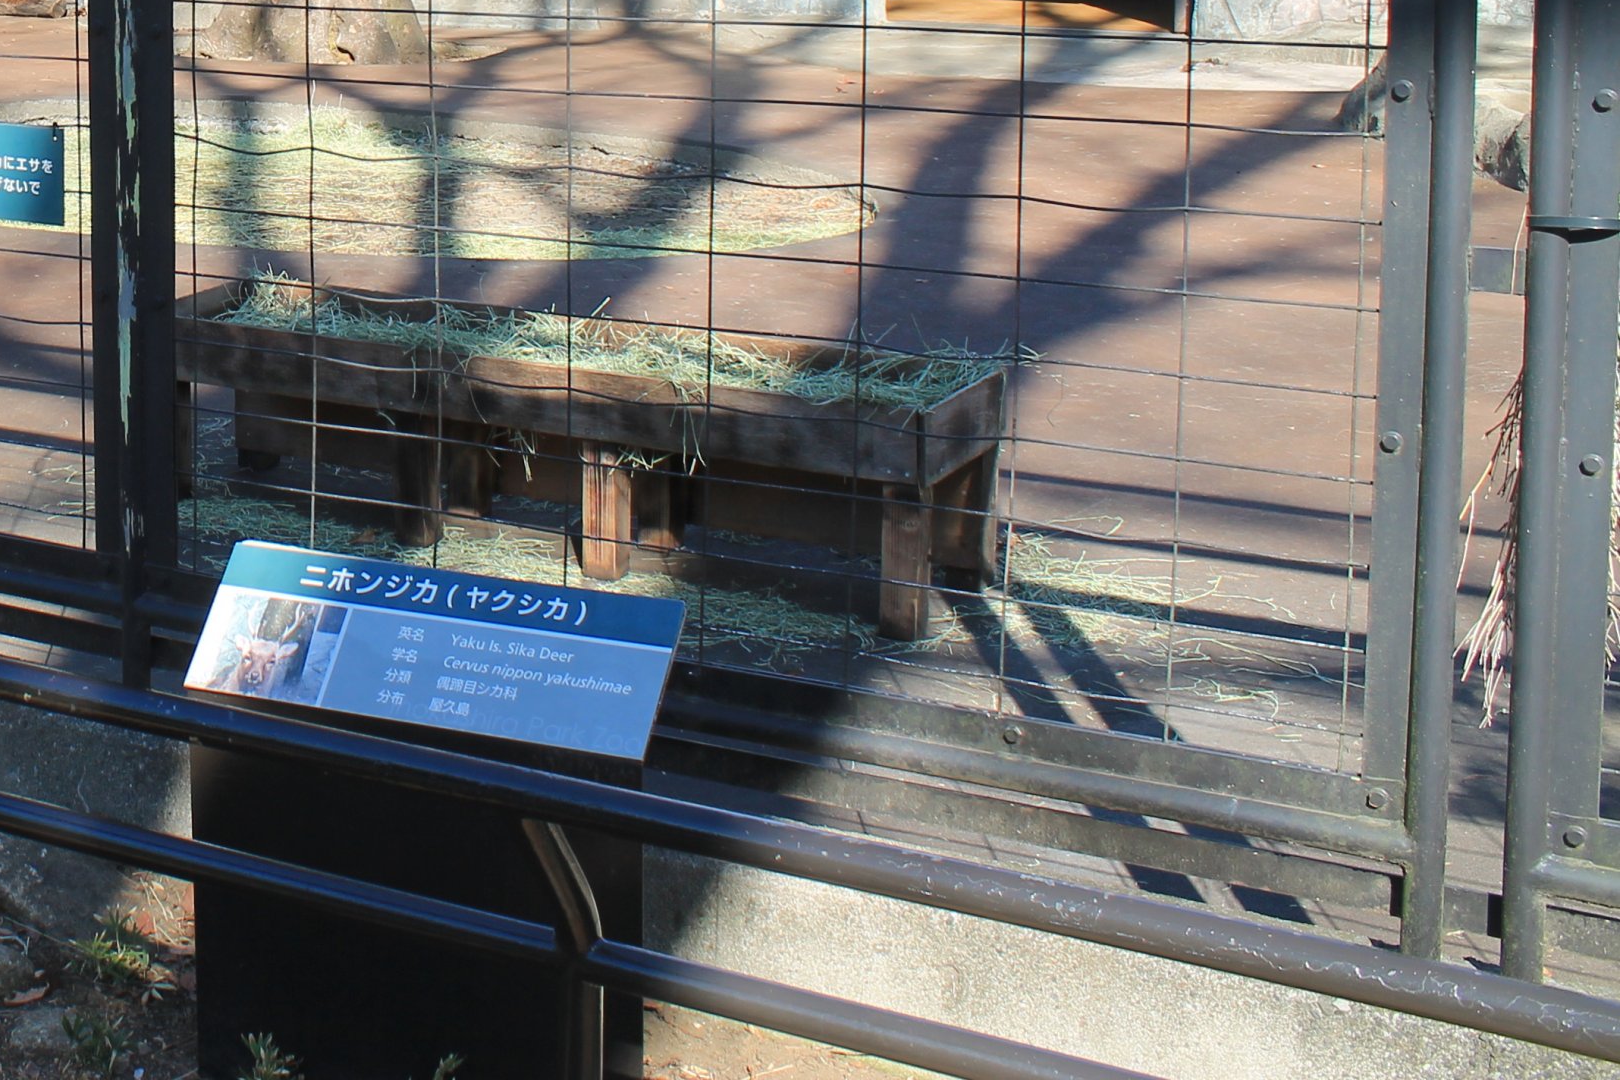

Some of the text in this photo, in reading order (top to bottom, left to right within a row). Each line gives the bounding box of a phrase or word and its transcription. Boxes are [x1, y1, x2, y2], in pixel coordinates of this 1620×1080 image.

[397, 625, 425, 642] 英名
[391, 646, 418, 664] 学名
[451, 633, 485, 652] Yaku
[507, 641, 535, 658] Sika
[539, 646, 575, 663] Deer
[384, 668, 413, 685] 分類
[443, 656, 633, 695] Cervus nippon yakushimae
[376, 689, 406, 706] 分布
[428, 696, 471, 717] 屋久島
